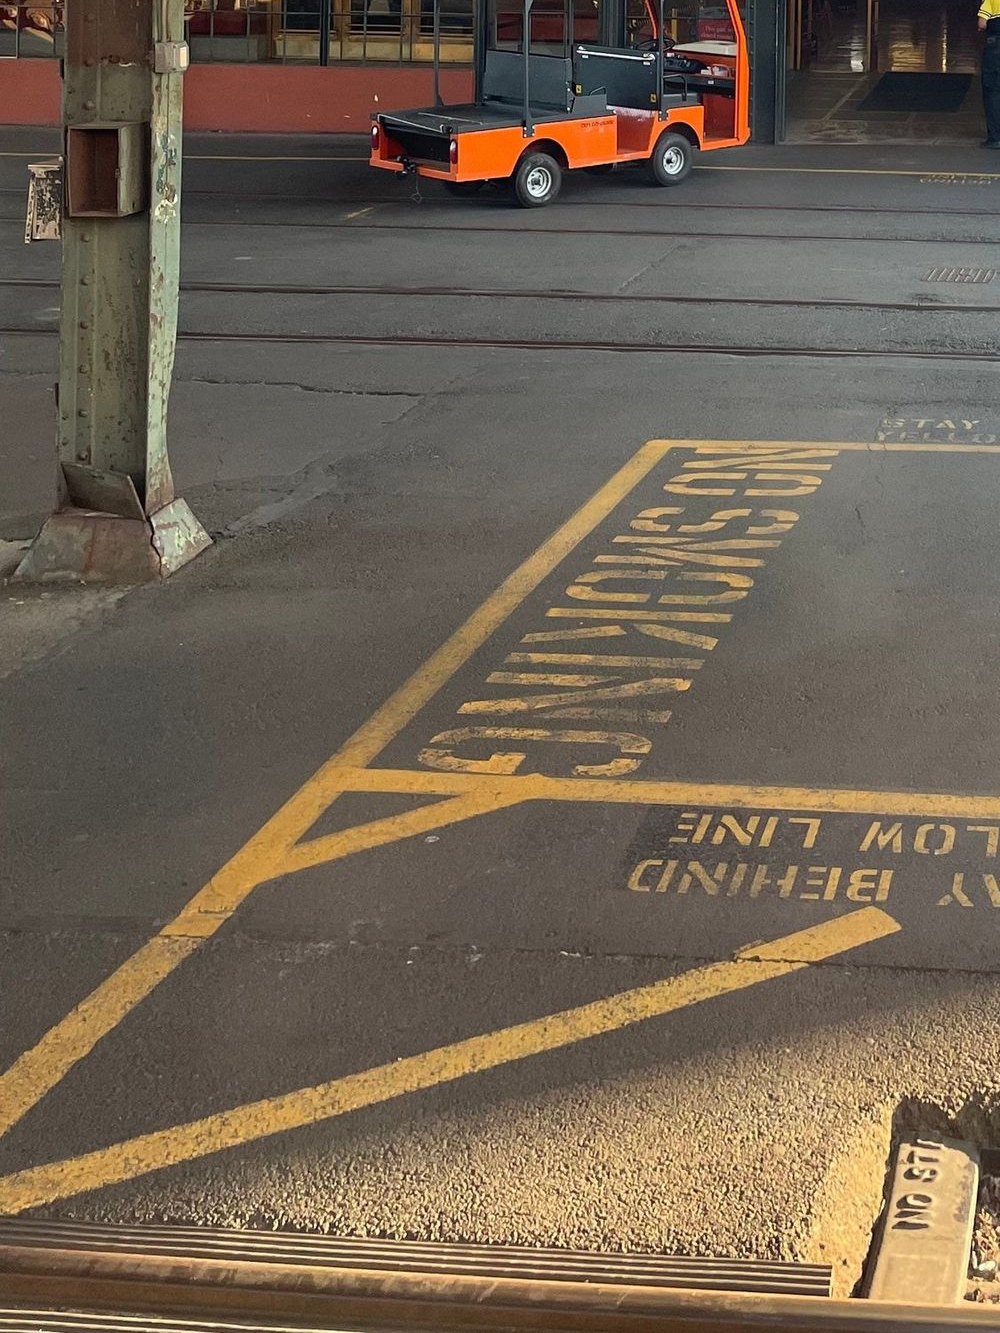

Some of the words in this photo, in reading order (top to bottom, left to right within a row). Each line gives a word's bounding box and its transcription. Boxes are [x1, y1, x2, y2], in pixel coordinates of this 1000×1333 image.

[881, 418, 980, 430] STAY
[663, 447, 840, 496] NO
[417, 506, 800, 777] SMOKING
[669, 812, 821, 849] LINE
[627, 858, 893, 903] BEHIND
[902, 1138, 945, 1183] ST
[892, 1193, 932, 1230] NO
